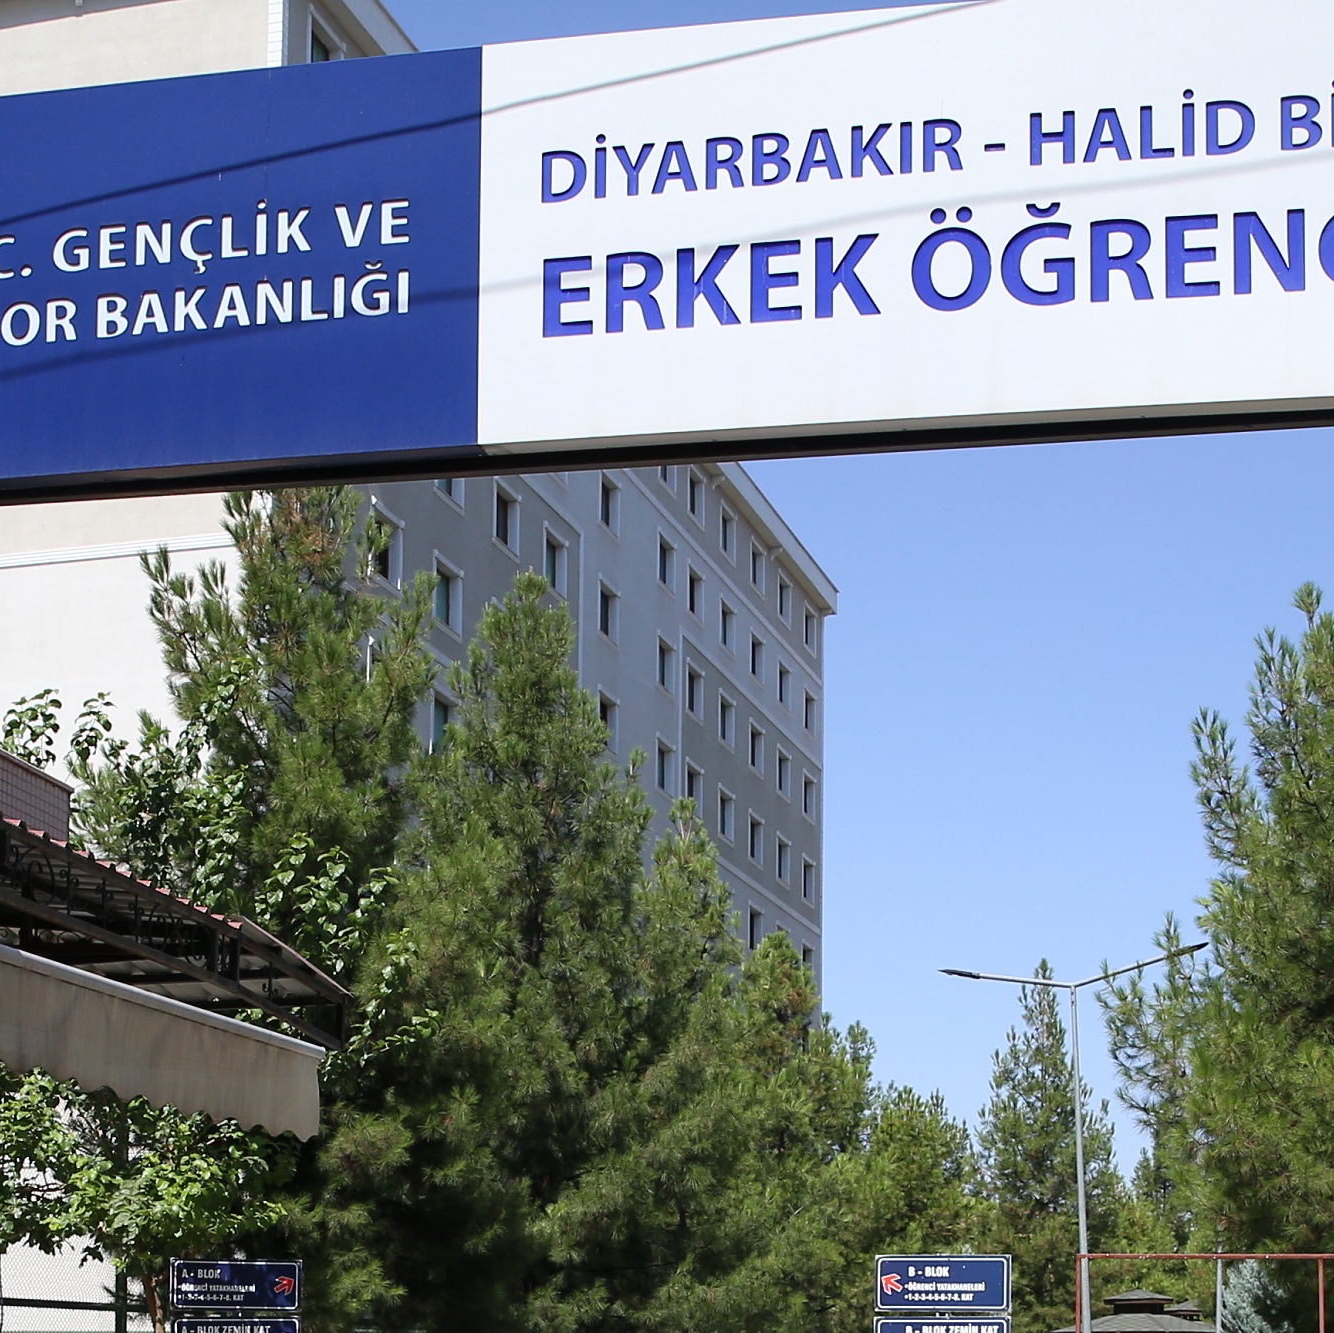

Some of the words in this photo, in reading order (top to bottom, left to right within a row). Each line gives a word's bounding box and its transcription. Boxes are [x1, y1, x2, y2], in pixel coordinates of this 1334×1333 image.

[542, 119, 962, 203] DİYARBAKIR
[984, 143, 1005, 151] -
[1030, 89, 1255, 165] HALİD
[53, 201, 312, 275] GENÇLİK
[336, 202, 409, 247] VE
[96, 261, 411, 339] BAKANLIĞI
[543, 233, 880, 337] ERKEK
[181, 1269, 188, 1278] A
[198, 1269, 221, 1278] BLOK
[908, 1266, 916, 1277] B
[925, 1266, 950, 1277] BLOK
[908, 1282, 935, 1291] ÖĞRENCİ
